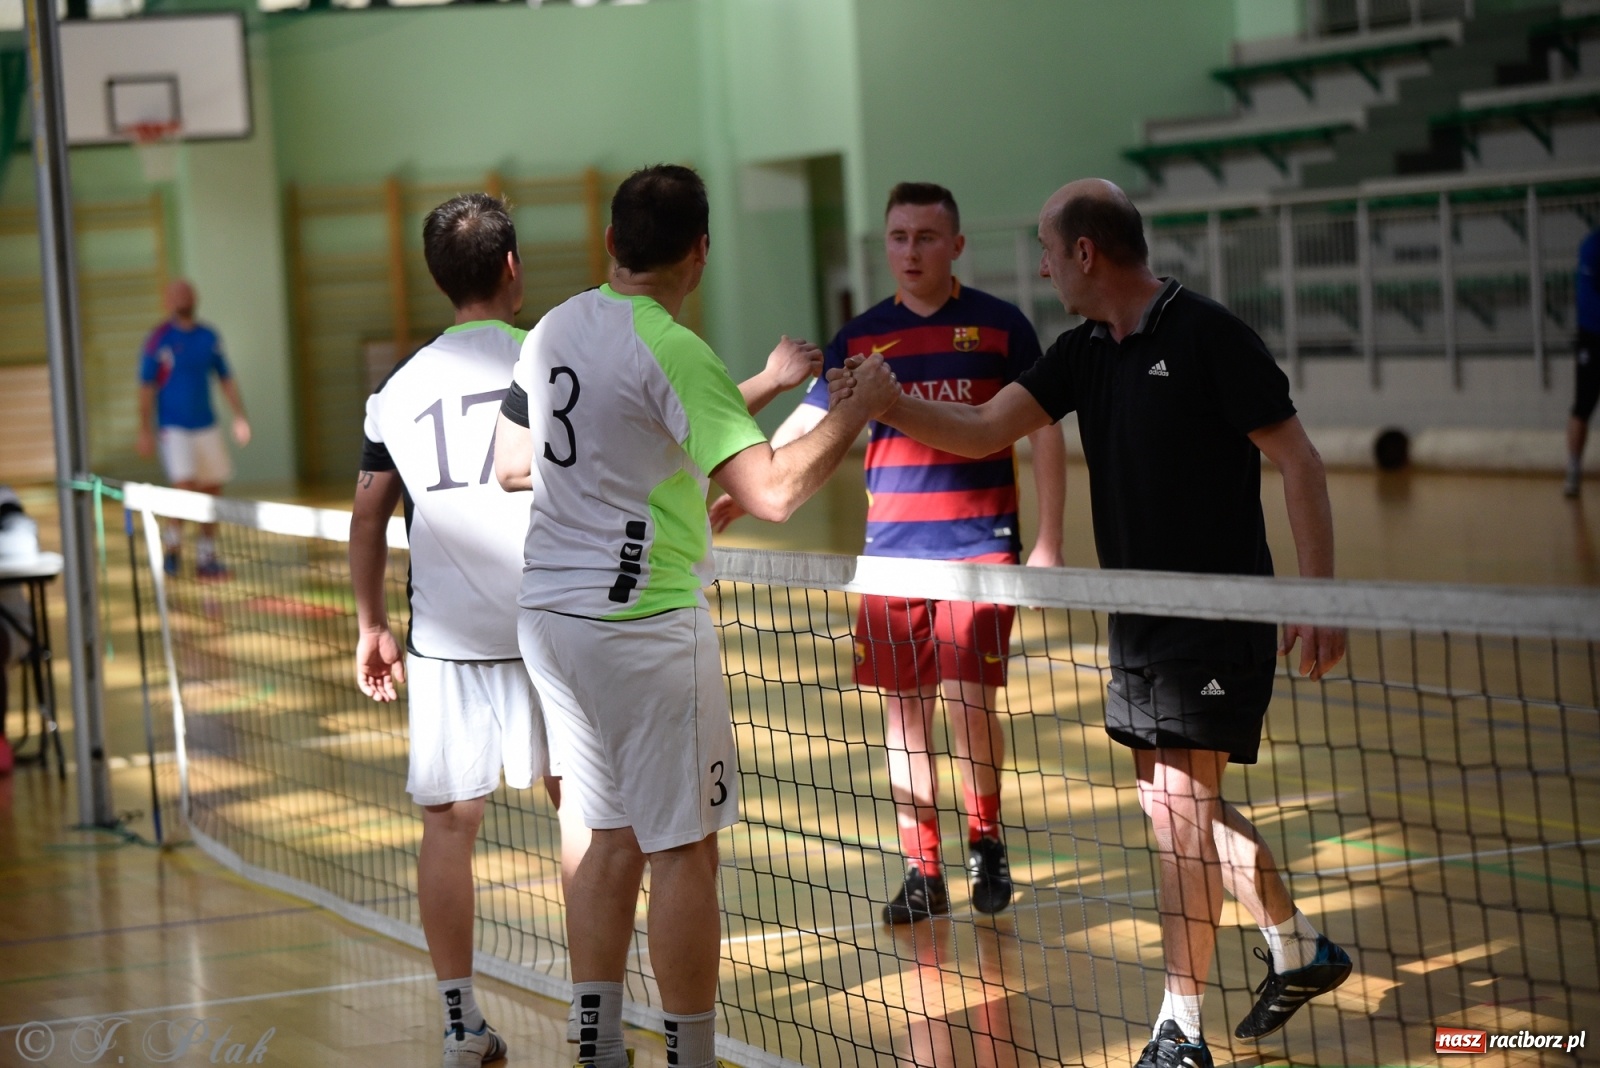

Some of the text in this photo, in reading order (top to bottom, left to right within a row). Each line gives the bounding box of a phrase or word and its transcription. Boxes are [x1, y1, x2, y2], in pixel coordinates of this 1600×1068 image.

[900, 378, 972, 401] ATAR
[1148, 369, 1170, 377] adidas
[413, 386, 511, 492] 17
[543, 366, 580, 468] 3
[710, 760, 728, 807] 3
